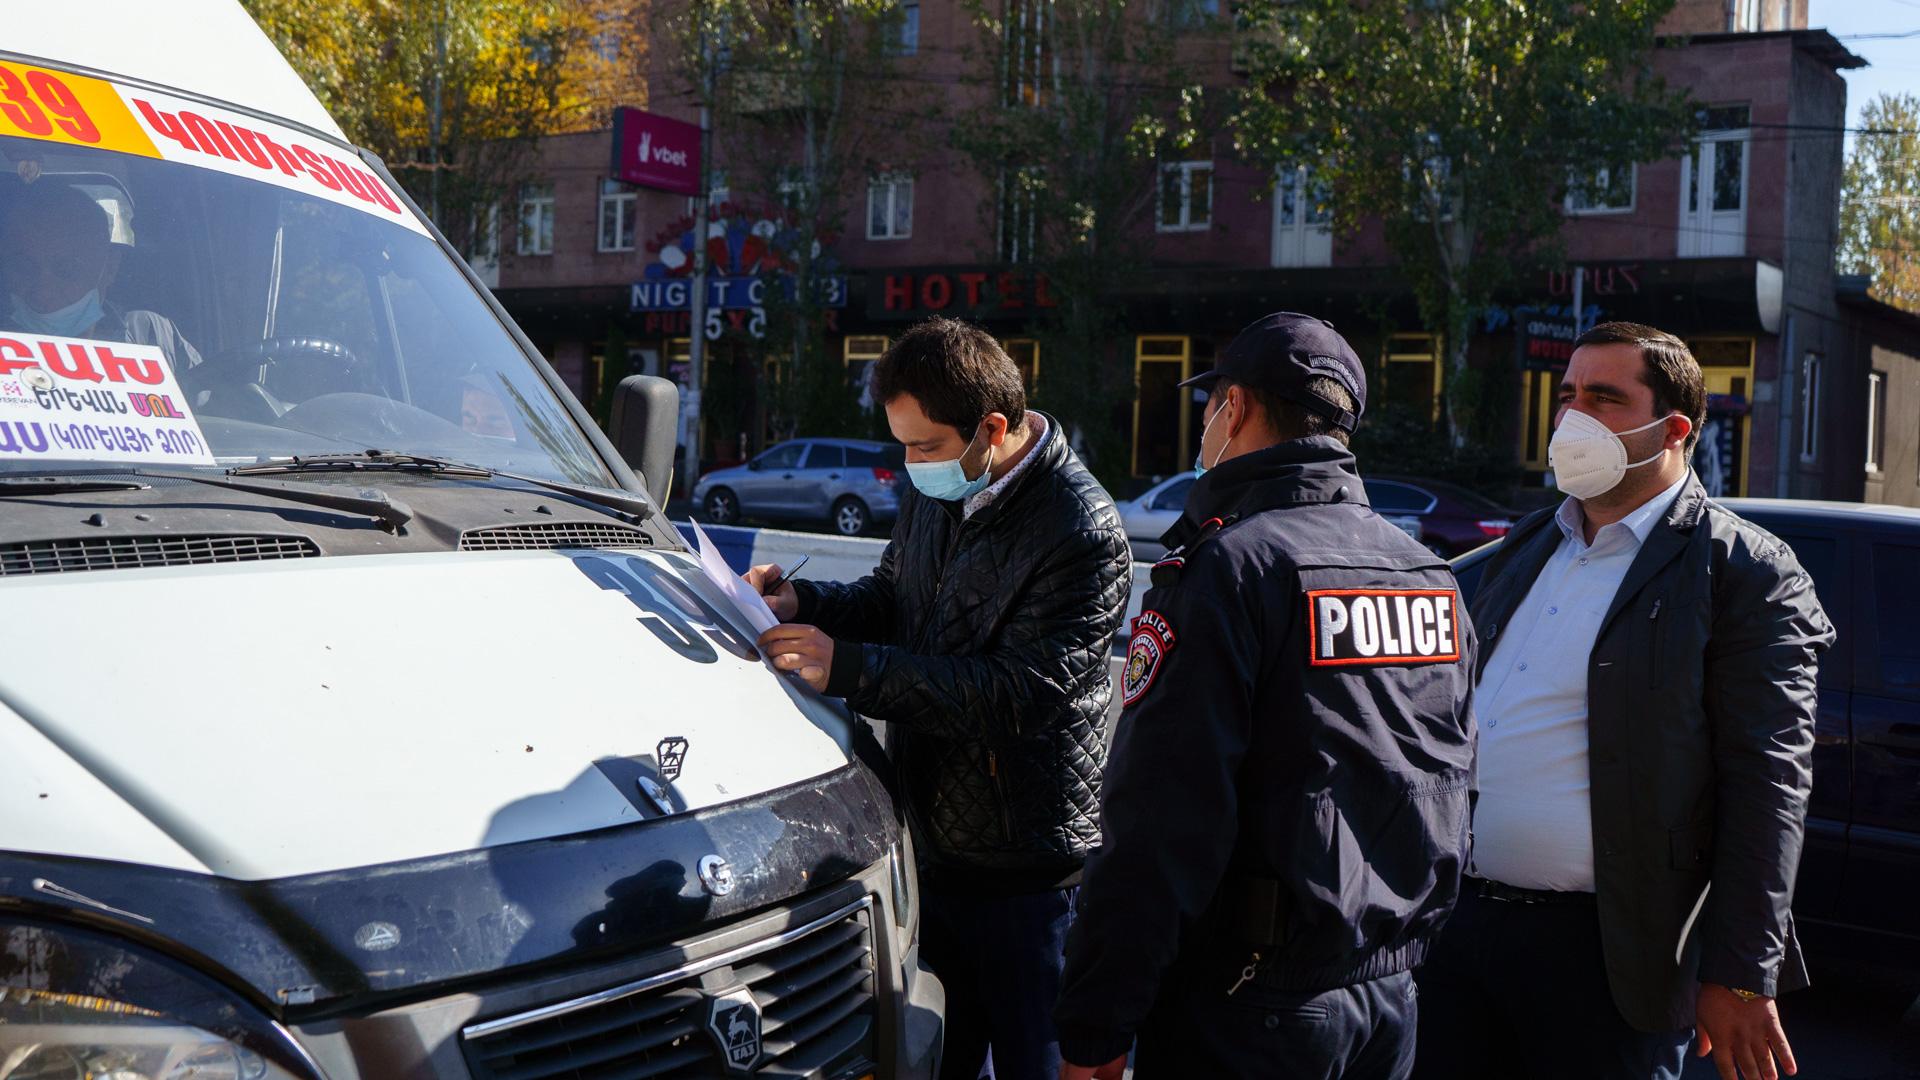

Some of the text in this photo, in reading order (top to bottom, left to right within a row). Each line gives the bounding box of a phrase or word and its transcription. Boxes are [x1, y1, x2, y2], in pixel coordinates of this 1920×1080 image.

[132, 97, 401, 214] ԿՈՄԻՏԱՍ
[652, 146, 688, 167] vbet
[632, 281, 731, 307] NIGT
[884, 272, 1057, 311] HOTEL
[32, 386, 186, 419] ԵՐԵՎԱՆ ՄՈԼ
[49, 423, 153, 452] (ԿՈՐԵԱՅԻ
[156, 428, 204, 456] ՁՈՐ)
[1138, 613, 1172, 643] POLICE
[1319, 595, 1453, 658] POLICE
[733, 1044, 755, 1062] ГАЗ
